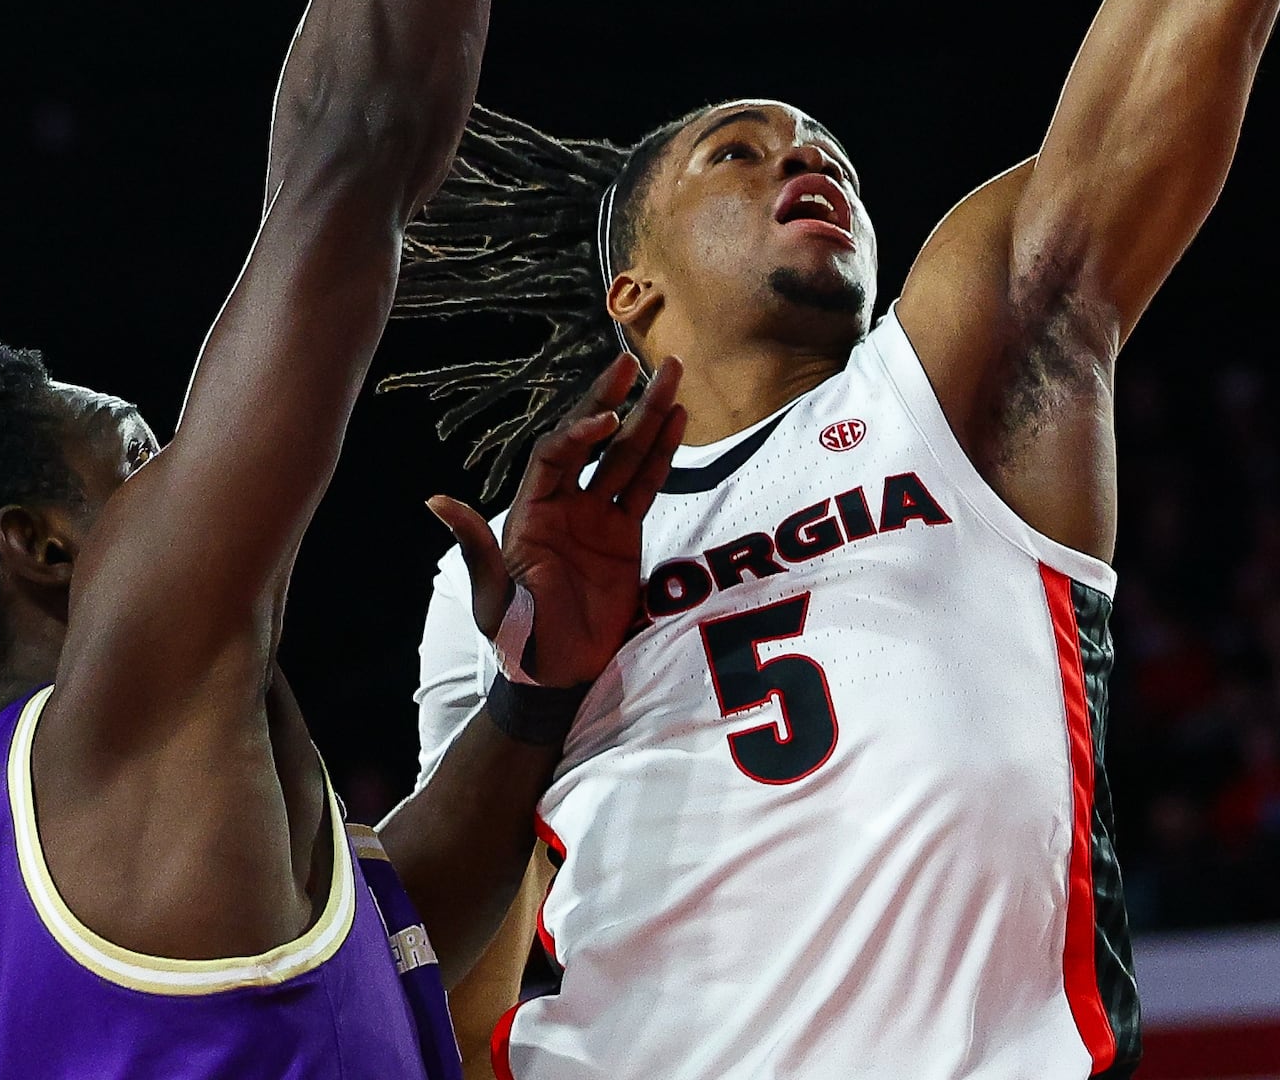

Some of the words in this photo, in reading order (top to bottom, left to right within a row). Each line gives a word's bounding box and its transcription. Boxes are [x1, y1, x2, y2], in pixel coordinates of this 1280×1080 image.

[823, 421, 863, 449] SEC
[645, 471, 953, 618] ORGIA
[698, 590, 840, 786] 5
